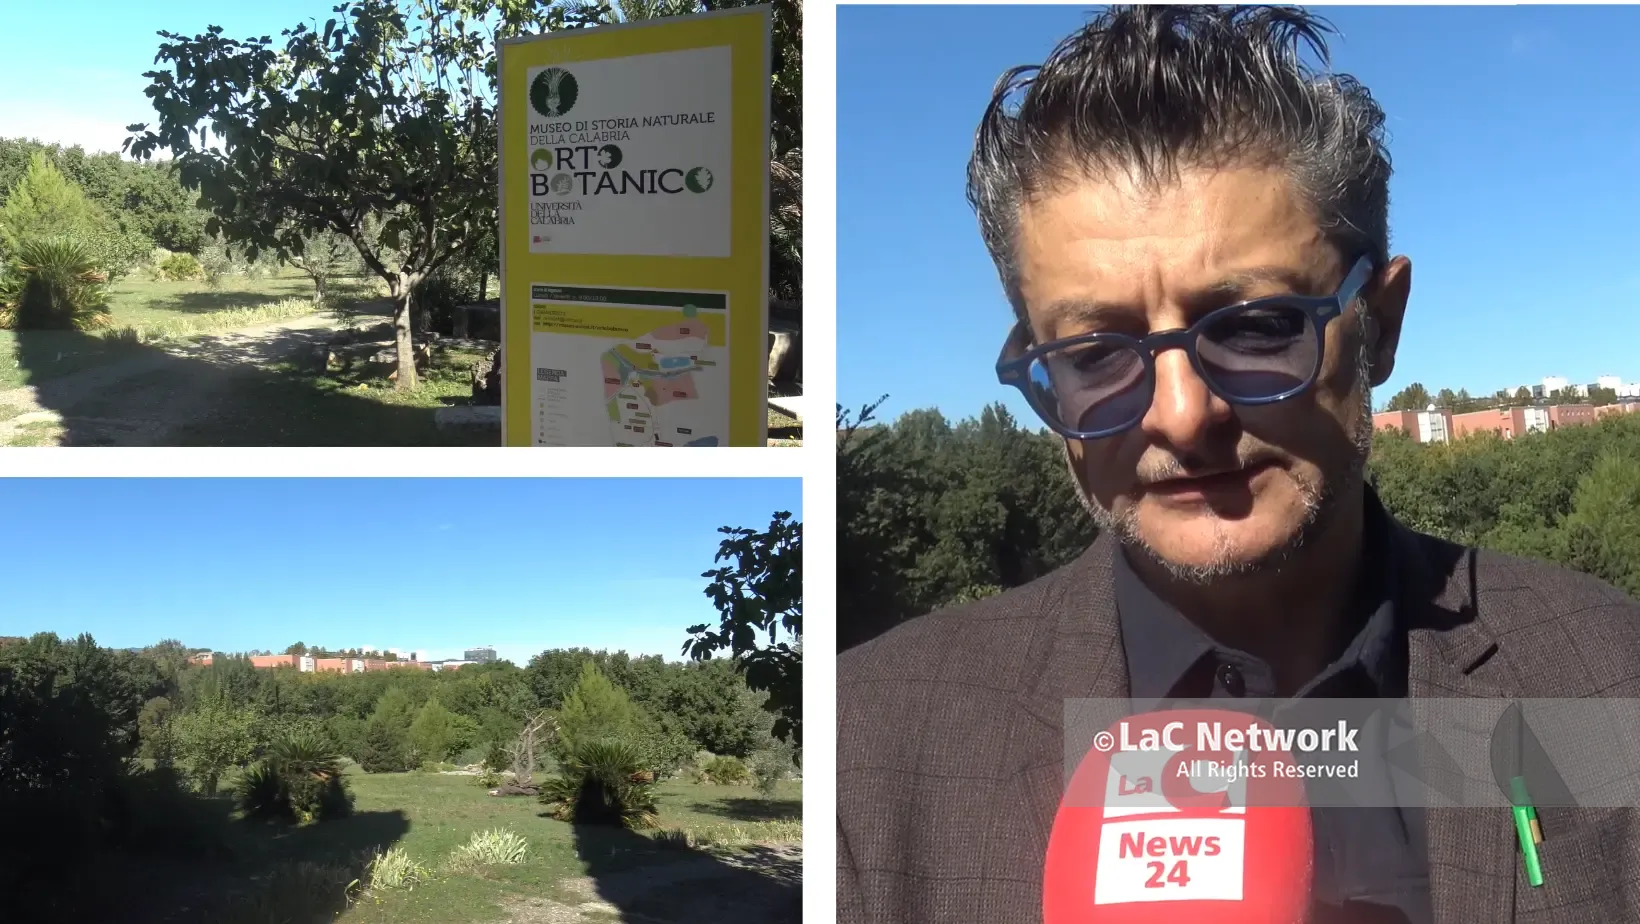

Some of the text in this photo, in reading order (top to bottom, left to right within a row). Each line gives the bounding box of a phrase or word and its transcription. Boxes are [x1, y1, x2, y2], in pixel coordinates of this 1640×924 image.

[530, 112, 715, 134] MUSEO DI STORIA NATURALE
[530, 130, 630, 145] DELLA CALABRIA
[531, 144, 623, 171] ORTO
[530, 166, 714, 196] BOTANICO
[530, 209, 560, 218] DELLA
[530, 216, 575, 225] CALABRIA
[1118, 831, 1221, 859] News
[1144, 860, 1191, 888] 24
